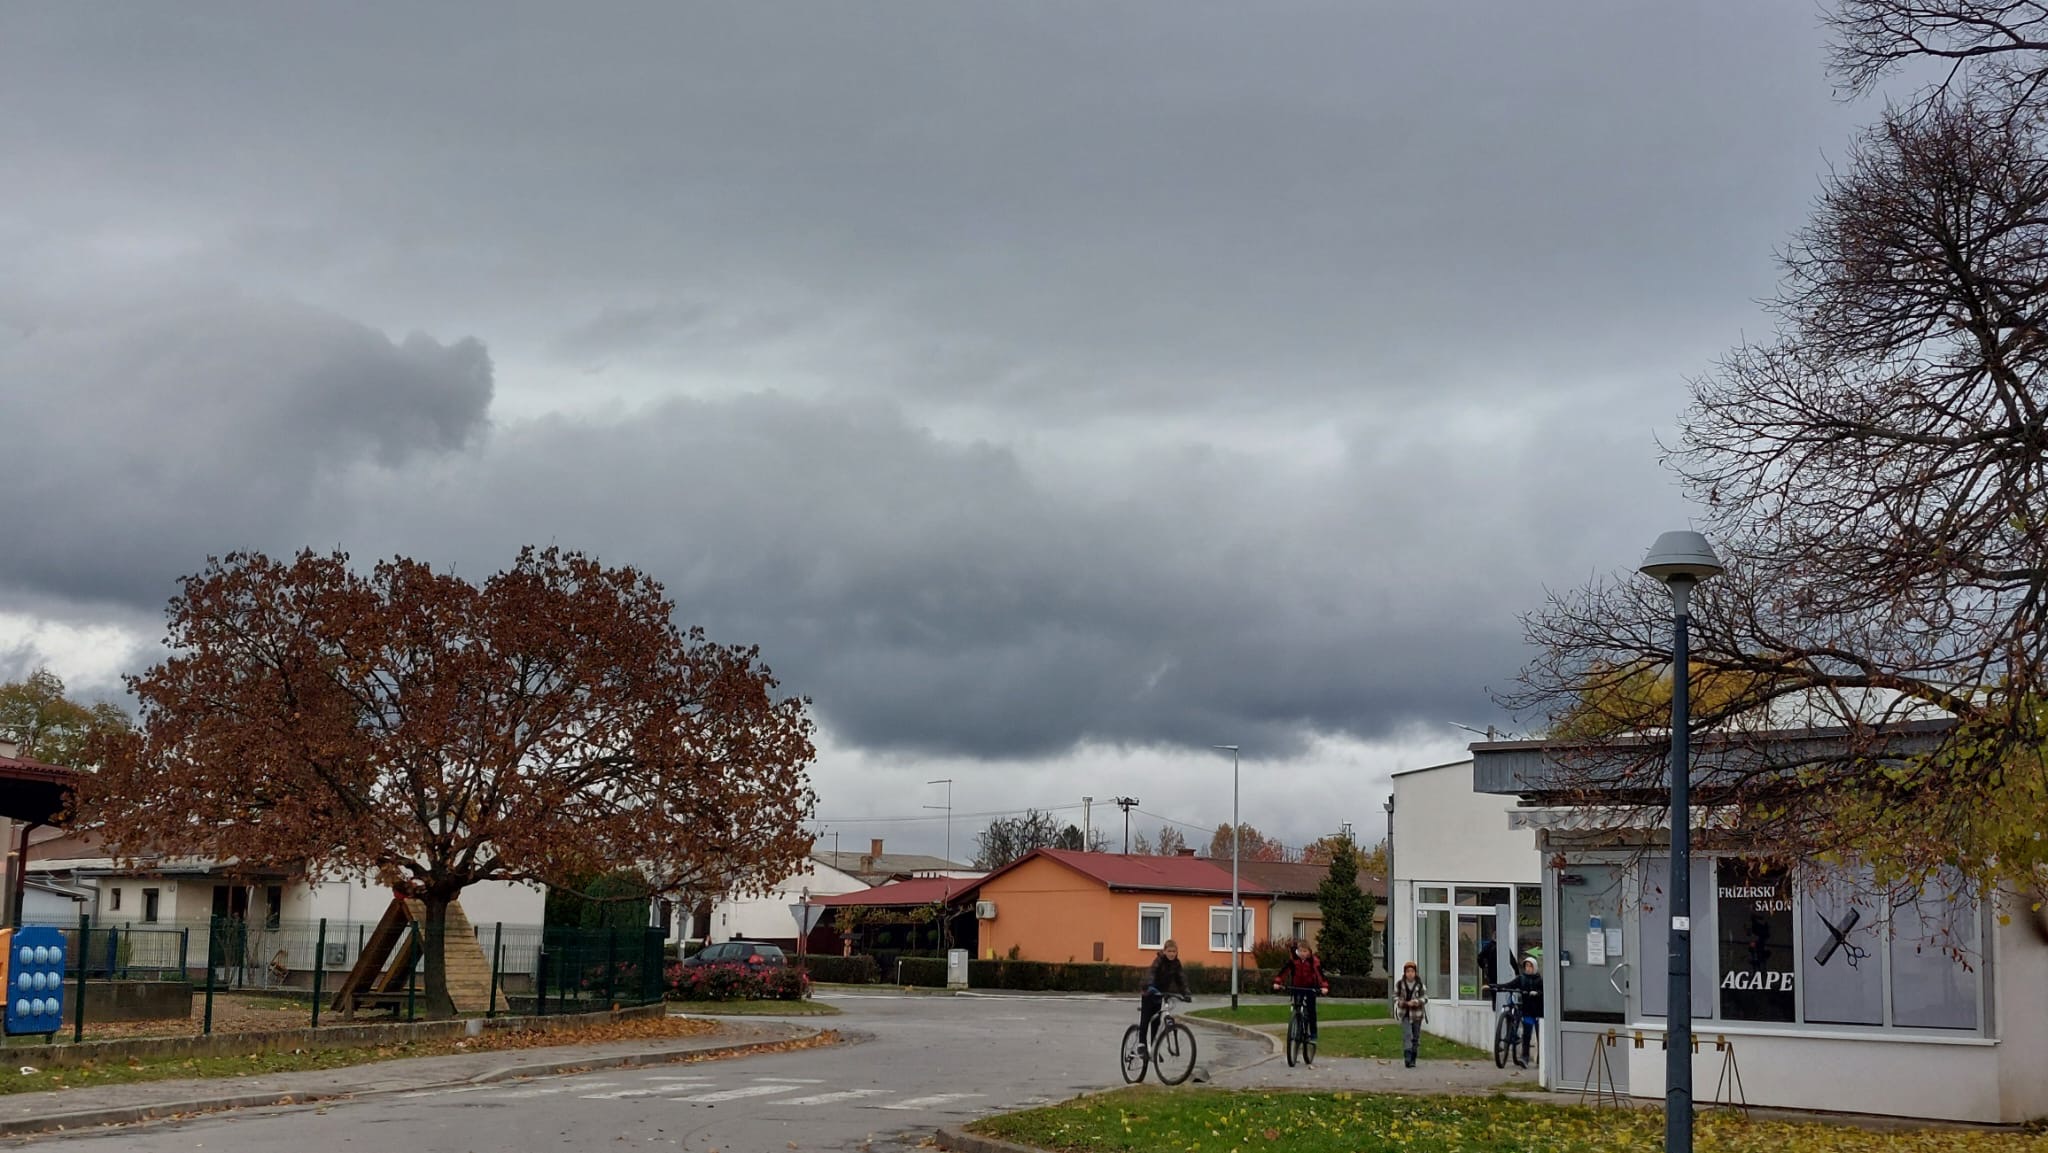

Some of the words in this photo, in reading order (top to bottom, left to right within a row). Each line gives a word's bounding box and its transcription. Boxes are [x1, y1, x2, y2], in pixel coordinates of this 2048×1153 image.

[1719, 886, 1775, 898] FRIZERSKI
[1755, 900, 1792, 911] SALON
[1721, 971, 1794, 991] AGAPE
